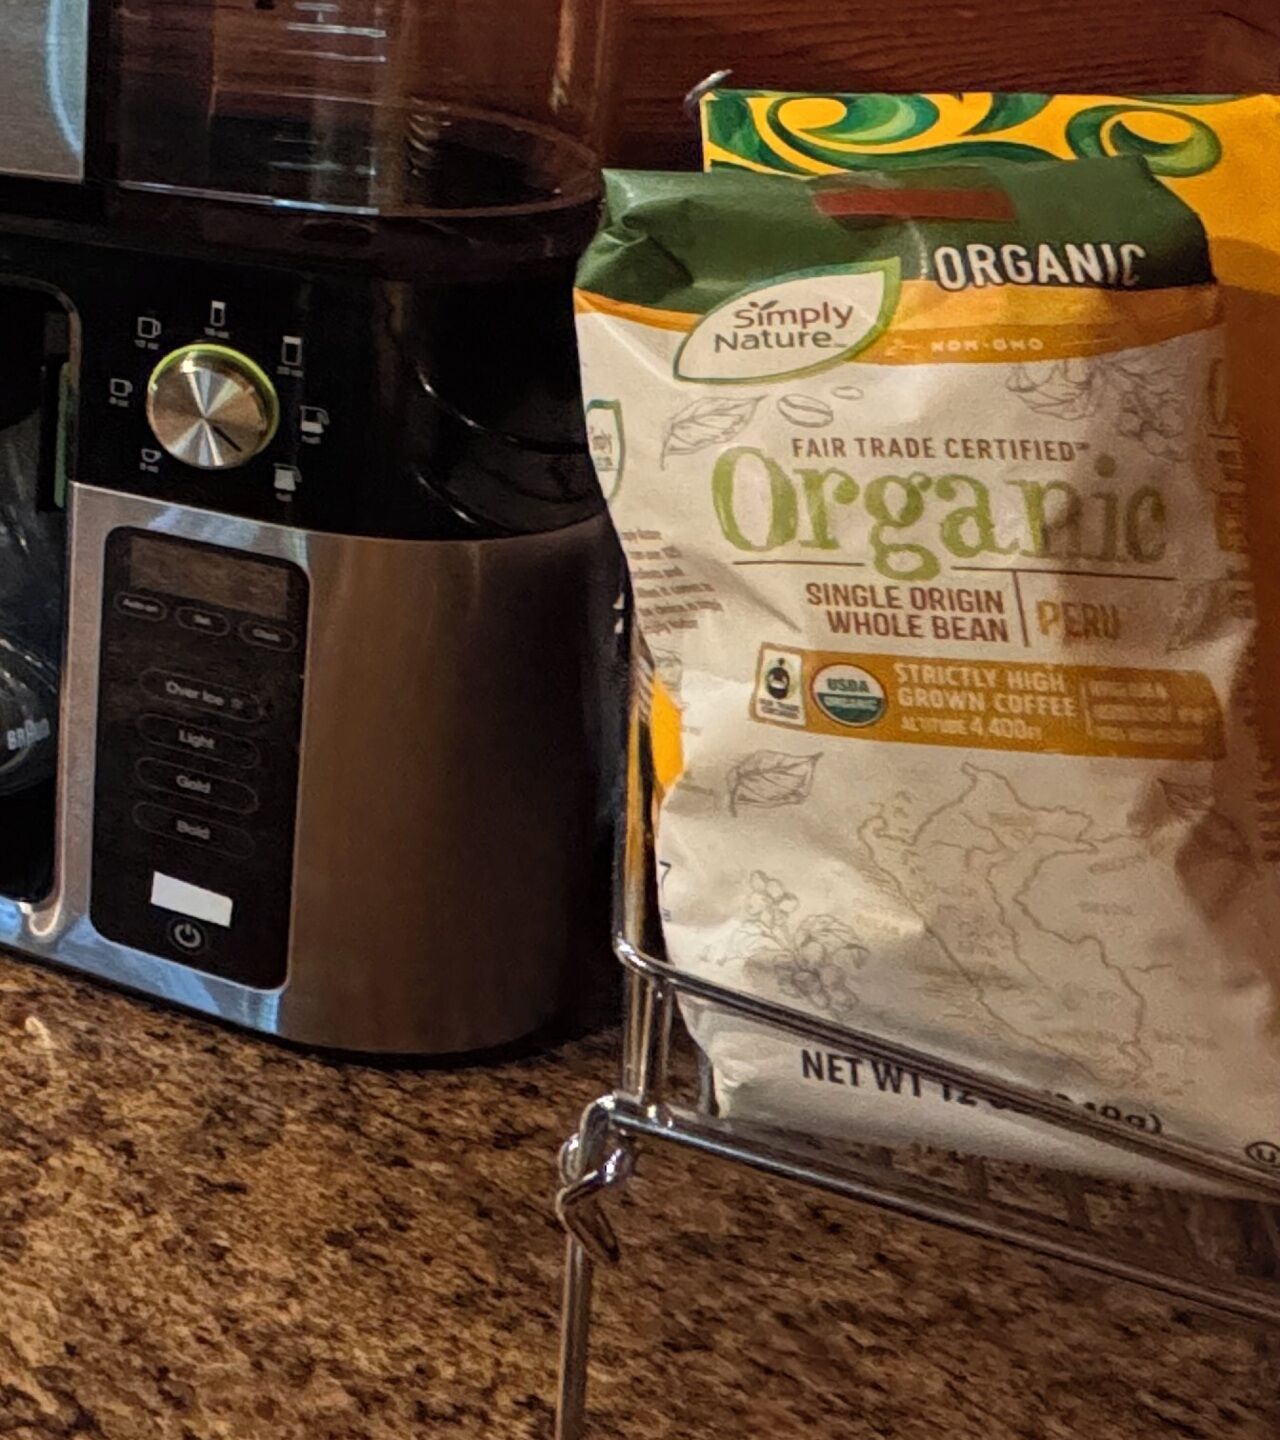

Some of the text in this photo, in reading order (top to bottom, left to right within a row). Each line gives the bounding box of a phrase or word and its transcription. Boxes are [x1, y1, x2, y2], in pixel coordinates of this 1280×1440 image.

[933, 243, 1146, 291] ORGANIC
[733, 300, 854, 329] Simply
[714, 329, 832, 353] Nature
[792, 437, 847, 458] FAIR
[857, 437, 936, 459] TRADE
[711, 446, 1167, 581] Organic
[806, 582, 1004, 614] SINGLE ORIGIN
[827, 610, 1010, 642] WHOLE BEAN
[1036, 599, 1122, 640] PERU
[165, 680, 200, 699] Over
[826, 678, 870, 693] USDA
[893, 663, 1065, 693] STRICTLY HIGH
[897, 687, 1077, 718] GROWN COFFEE
[178, 729, 215, 750] Light
[176, 775, 211, 794] Gold
[176, 820, 210, 840] Bold
[800, 1049, 864, 1086] NET
[870, 1062, 922, 1098] WT
